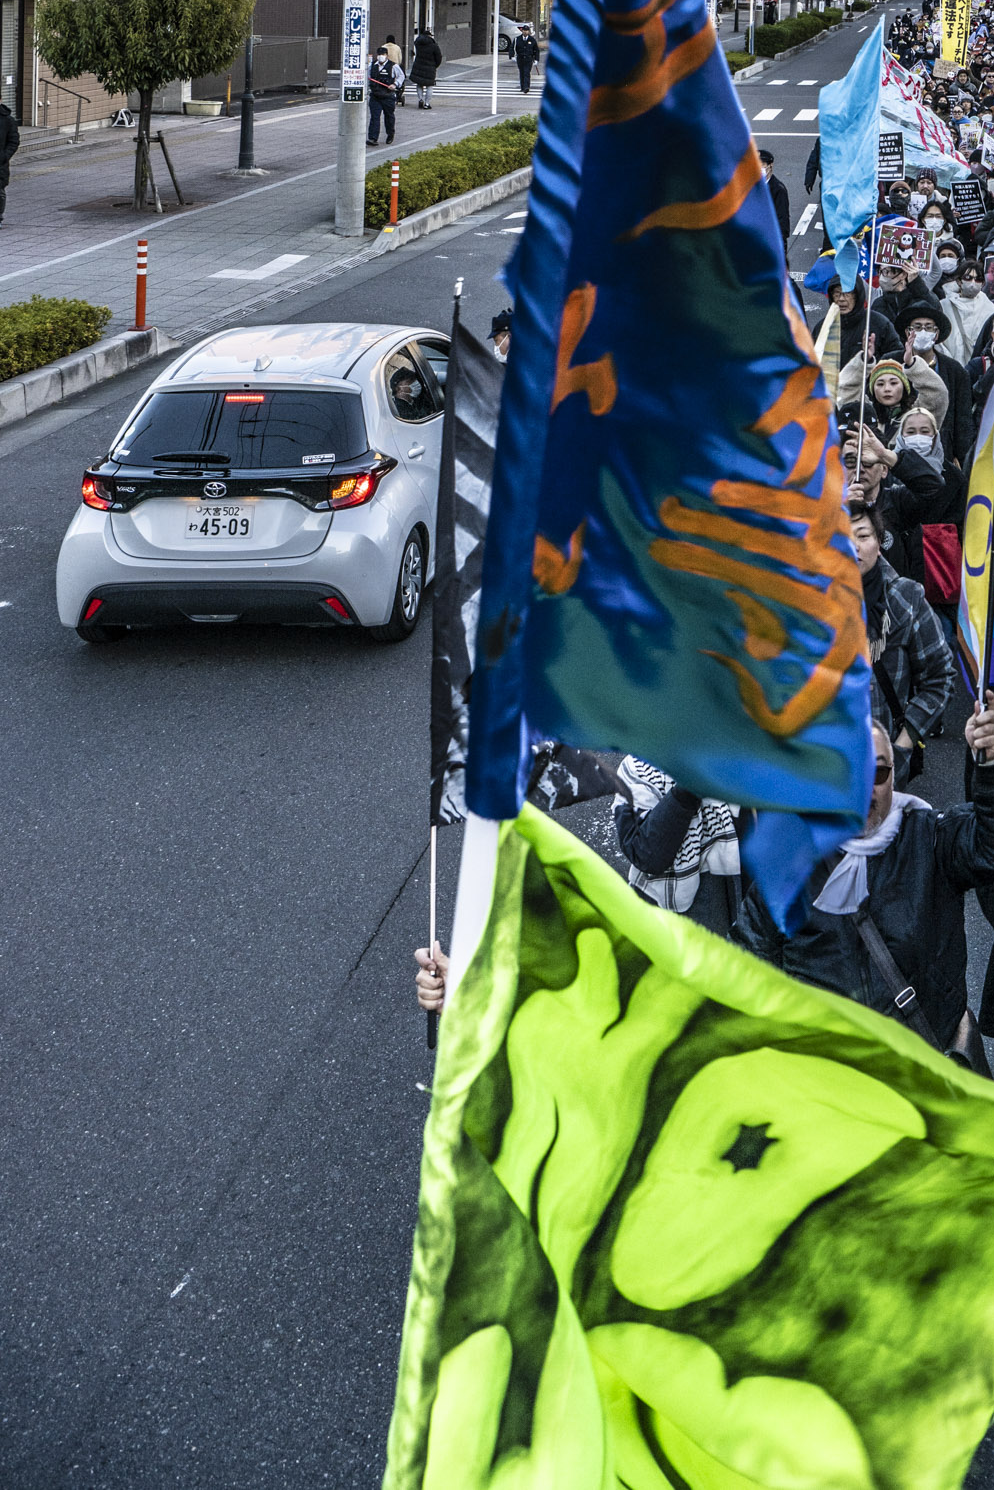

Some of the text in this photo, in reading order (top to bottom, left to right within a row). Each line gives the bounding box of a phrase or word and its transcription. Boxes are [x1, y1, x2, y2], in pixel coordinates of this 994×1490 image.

[349, 8, 361, 68] かしま歯科
[188, 518, 249, 536] わ 45-09
